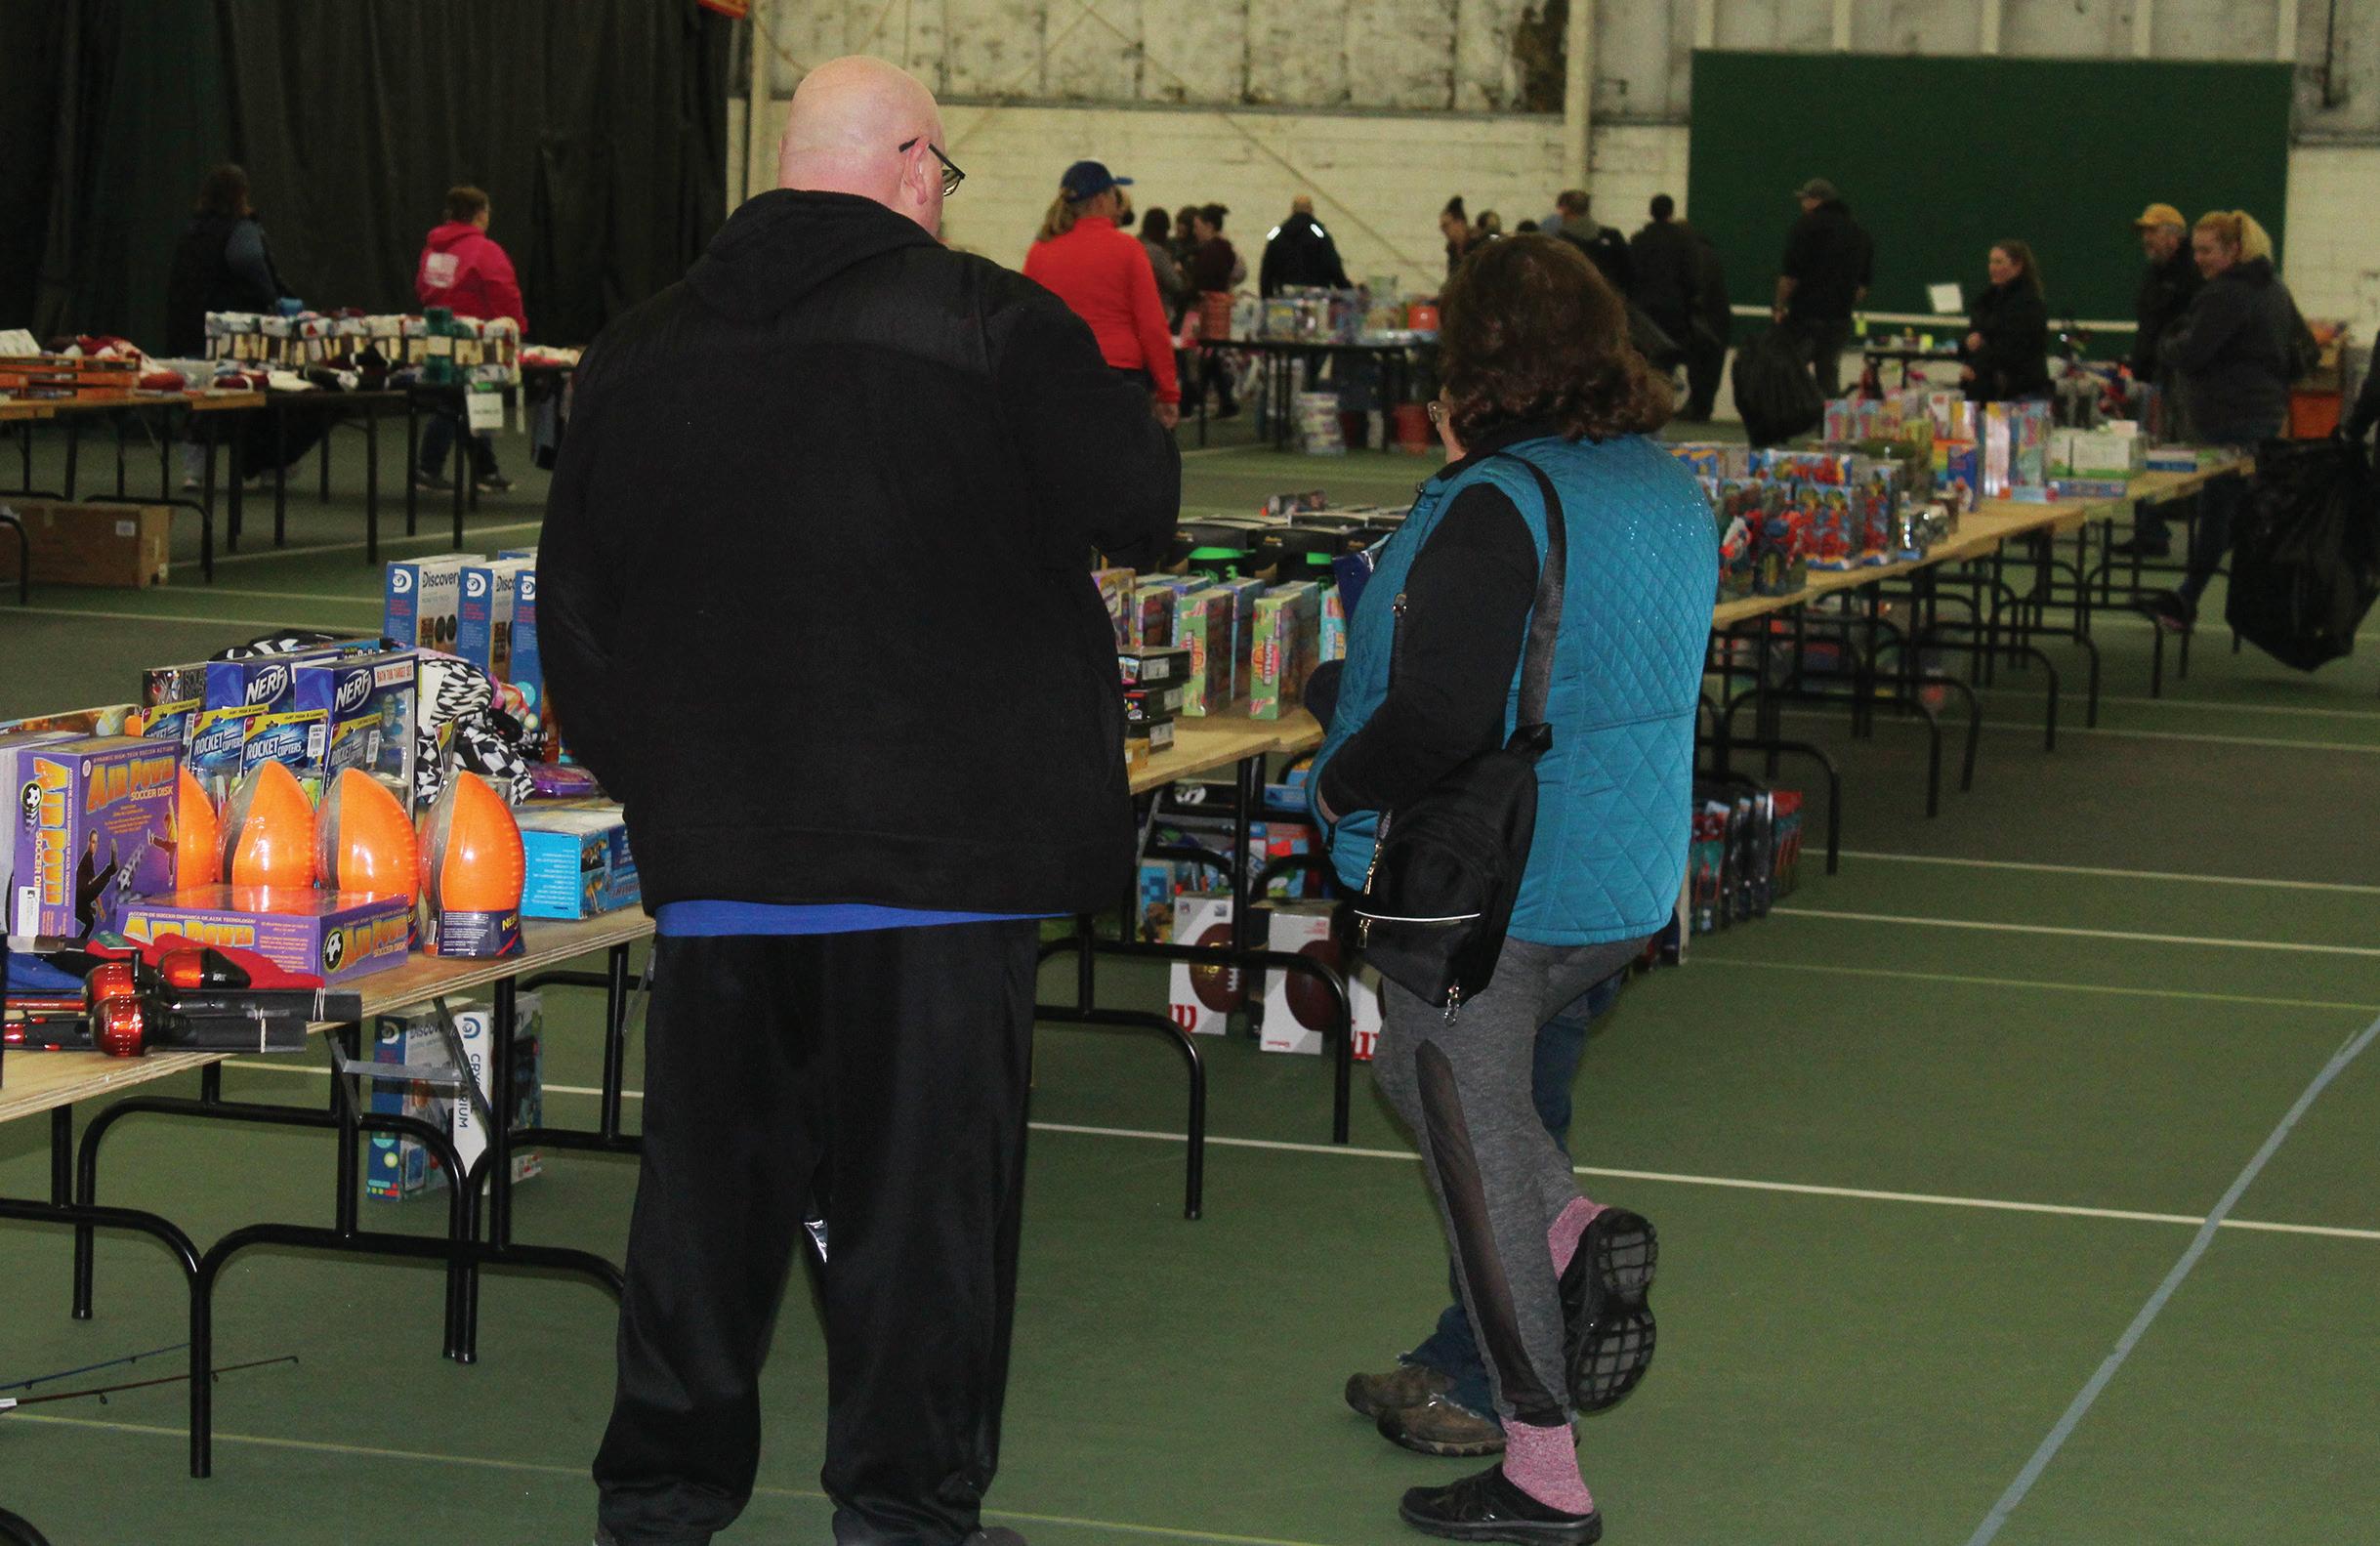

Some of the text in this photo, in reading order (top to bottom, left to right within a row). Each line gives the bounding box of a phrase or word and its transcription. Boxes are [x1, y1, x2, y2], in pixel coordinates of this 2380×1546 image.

[244, 665, 286, 706] NERF
[334, 669, 371, 712] NERF
[194, 732, 224, 755] ROCKET
[246, 736, 302, 761] ROCKET COPTERS
[33, 757, 68, 827] AIR
[86, 756, 175, 815] AIR POWER
[130, 785, 173, 801] SOCCER DISK
[34, 831, 43, 874] SOCCER
[184, 919, 256, 946] POWER
